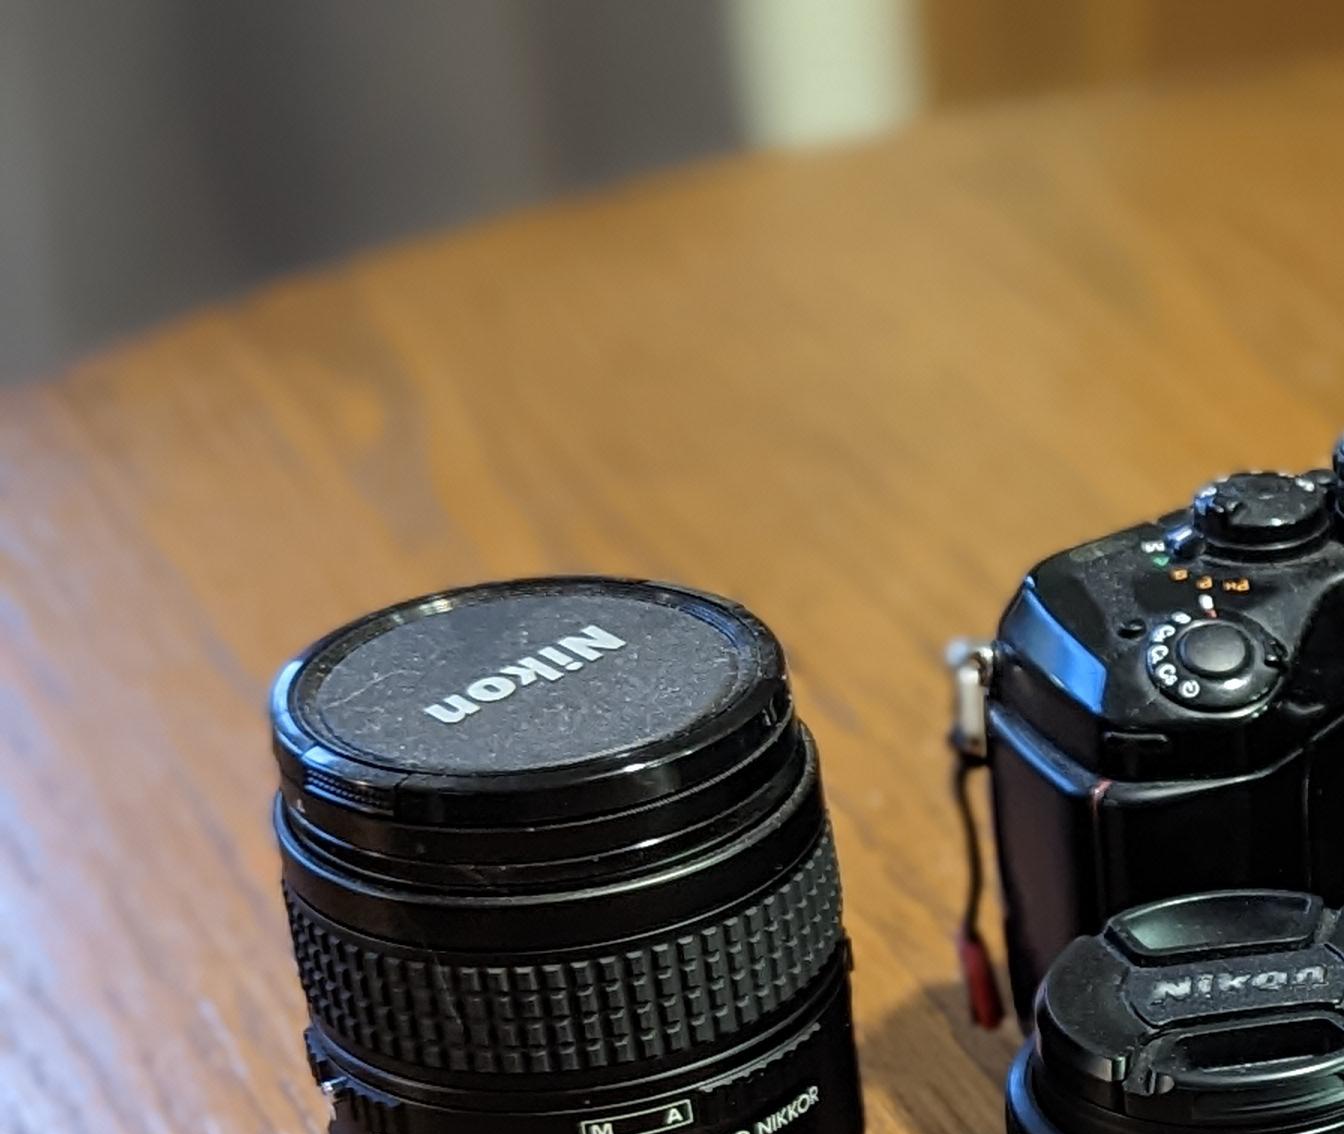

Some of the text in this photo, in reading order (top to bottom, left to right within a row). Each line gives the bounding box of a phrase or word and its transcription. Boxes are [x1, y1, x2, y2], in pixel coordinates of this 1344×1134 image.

[423, 624, 627, 725] Nikon
[1151, 965, 1328, 1001] Nikon
[666, 1108, 683, 1124] A
